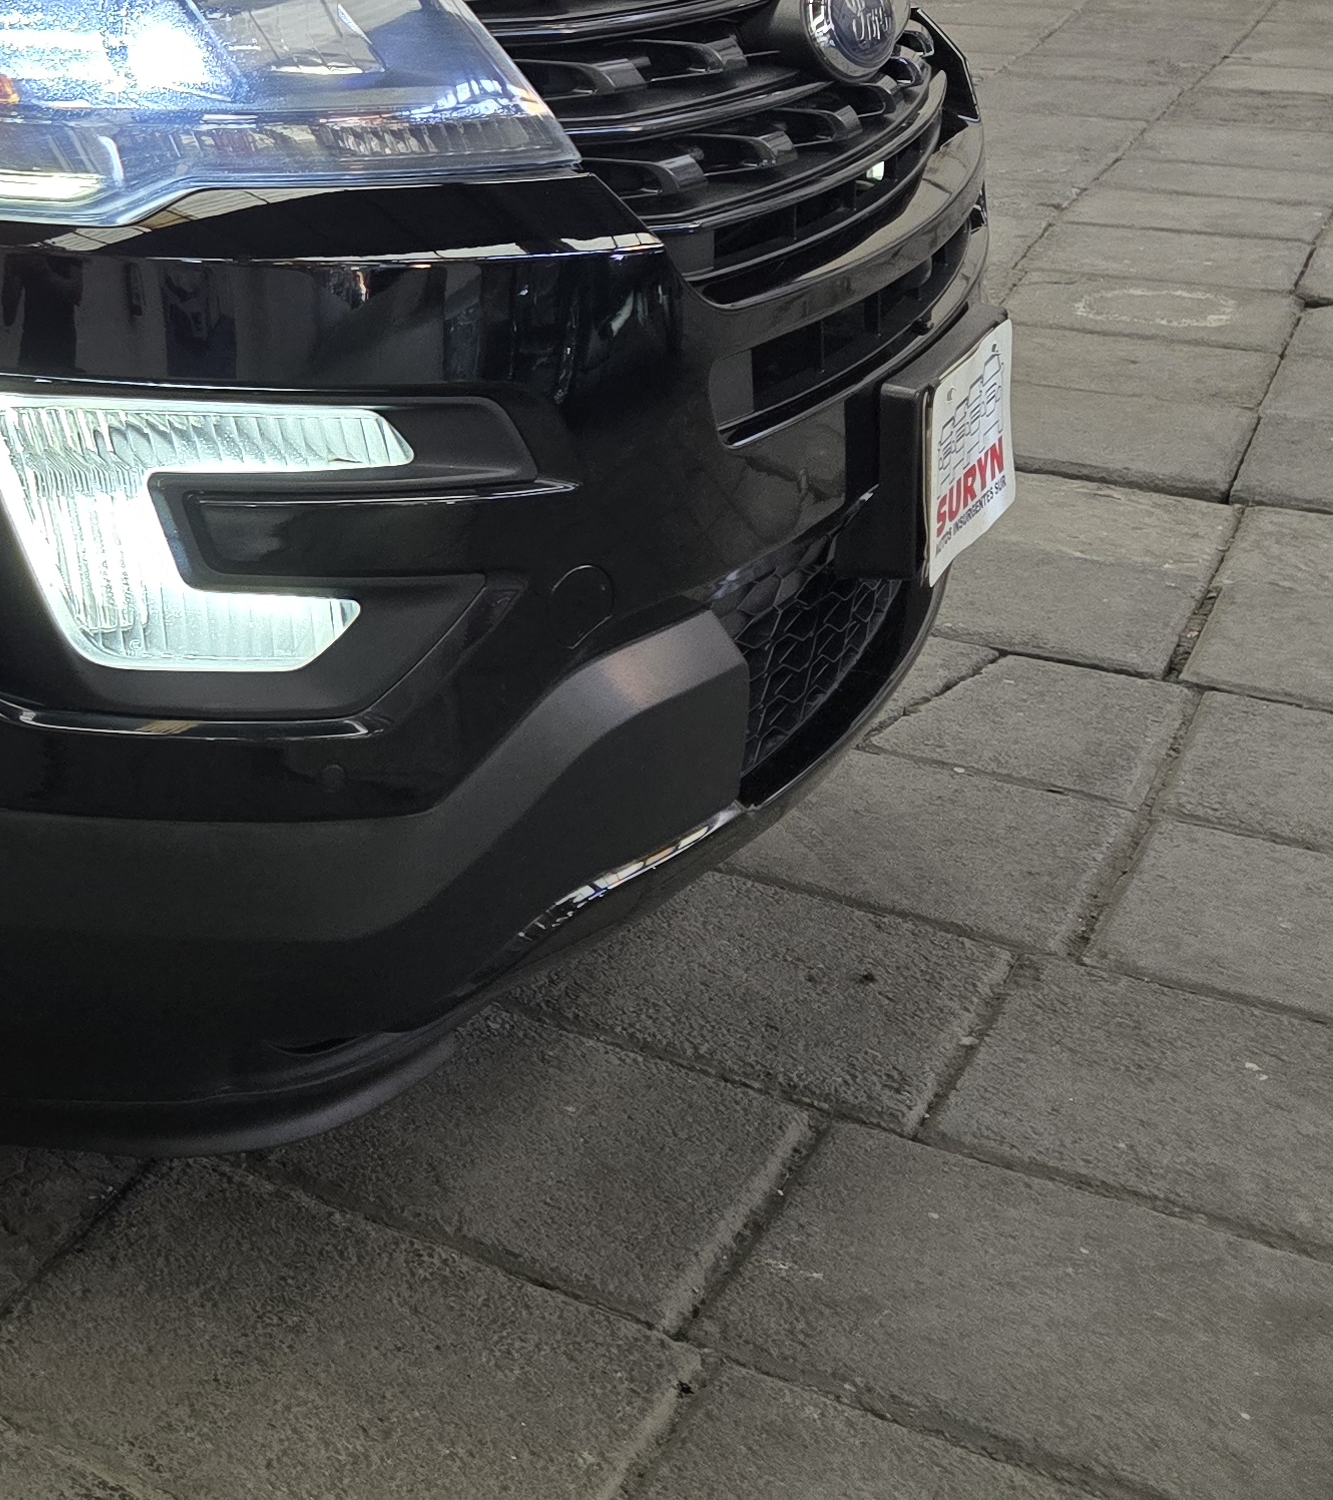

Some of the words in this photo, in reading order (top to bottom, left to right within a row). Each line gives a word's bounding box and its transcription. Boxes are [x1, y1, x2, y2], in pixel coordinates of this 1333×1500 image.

[936, 435, 1005, 538] SURYN
[953, 486, 994, 534] INSURGENTES
[994, 474, 1007, 496] SUR
